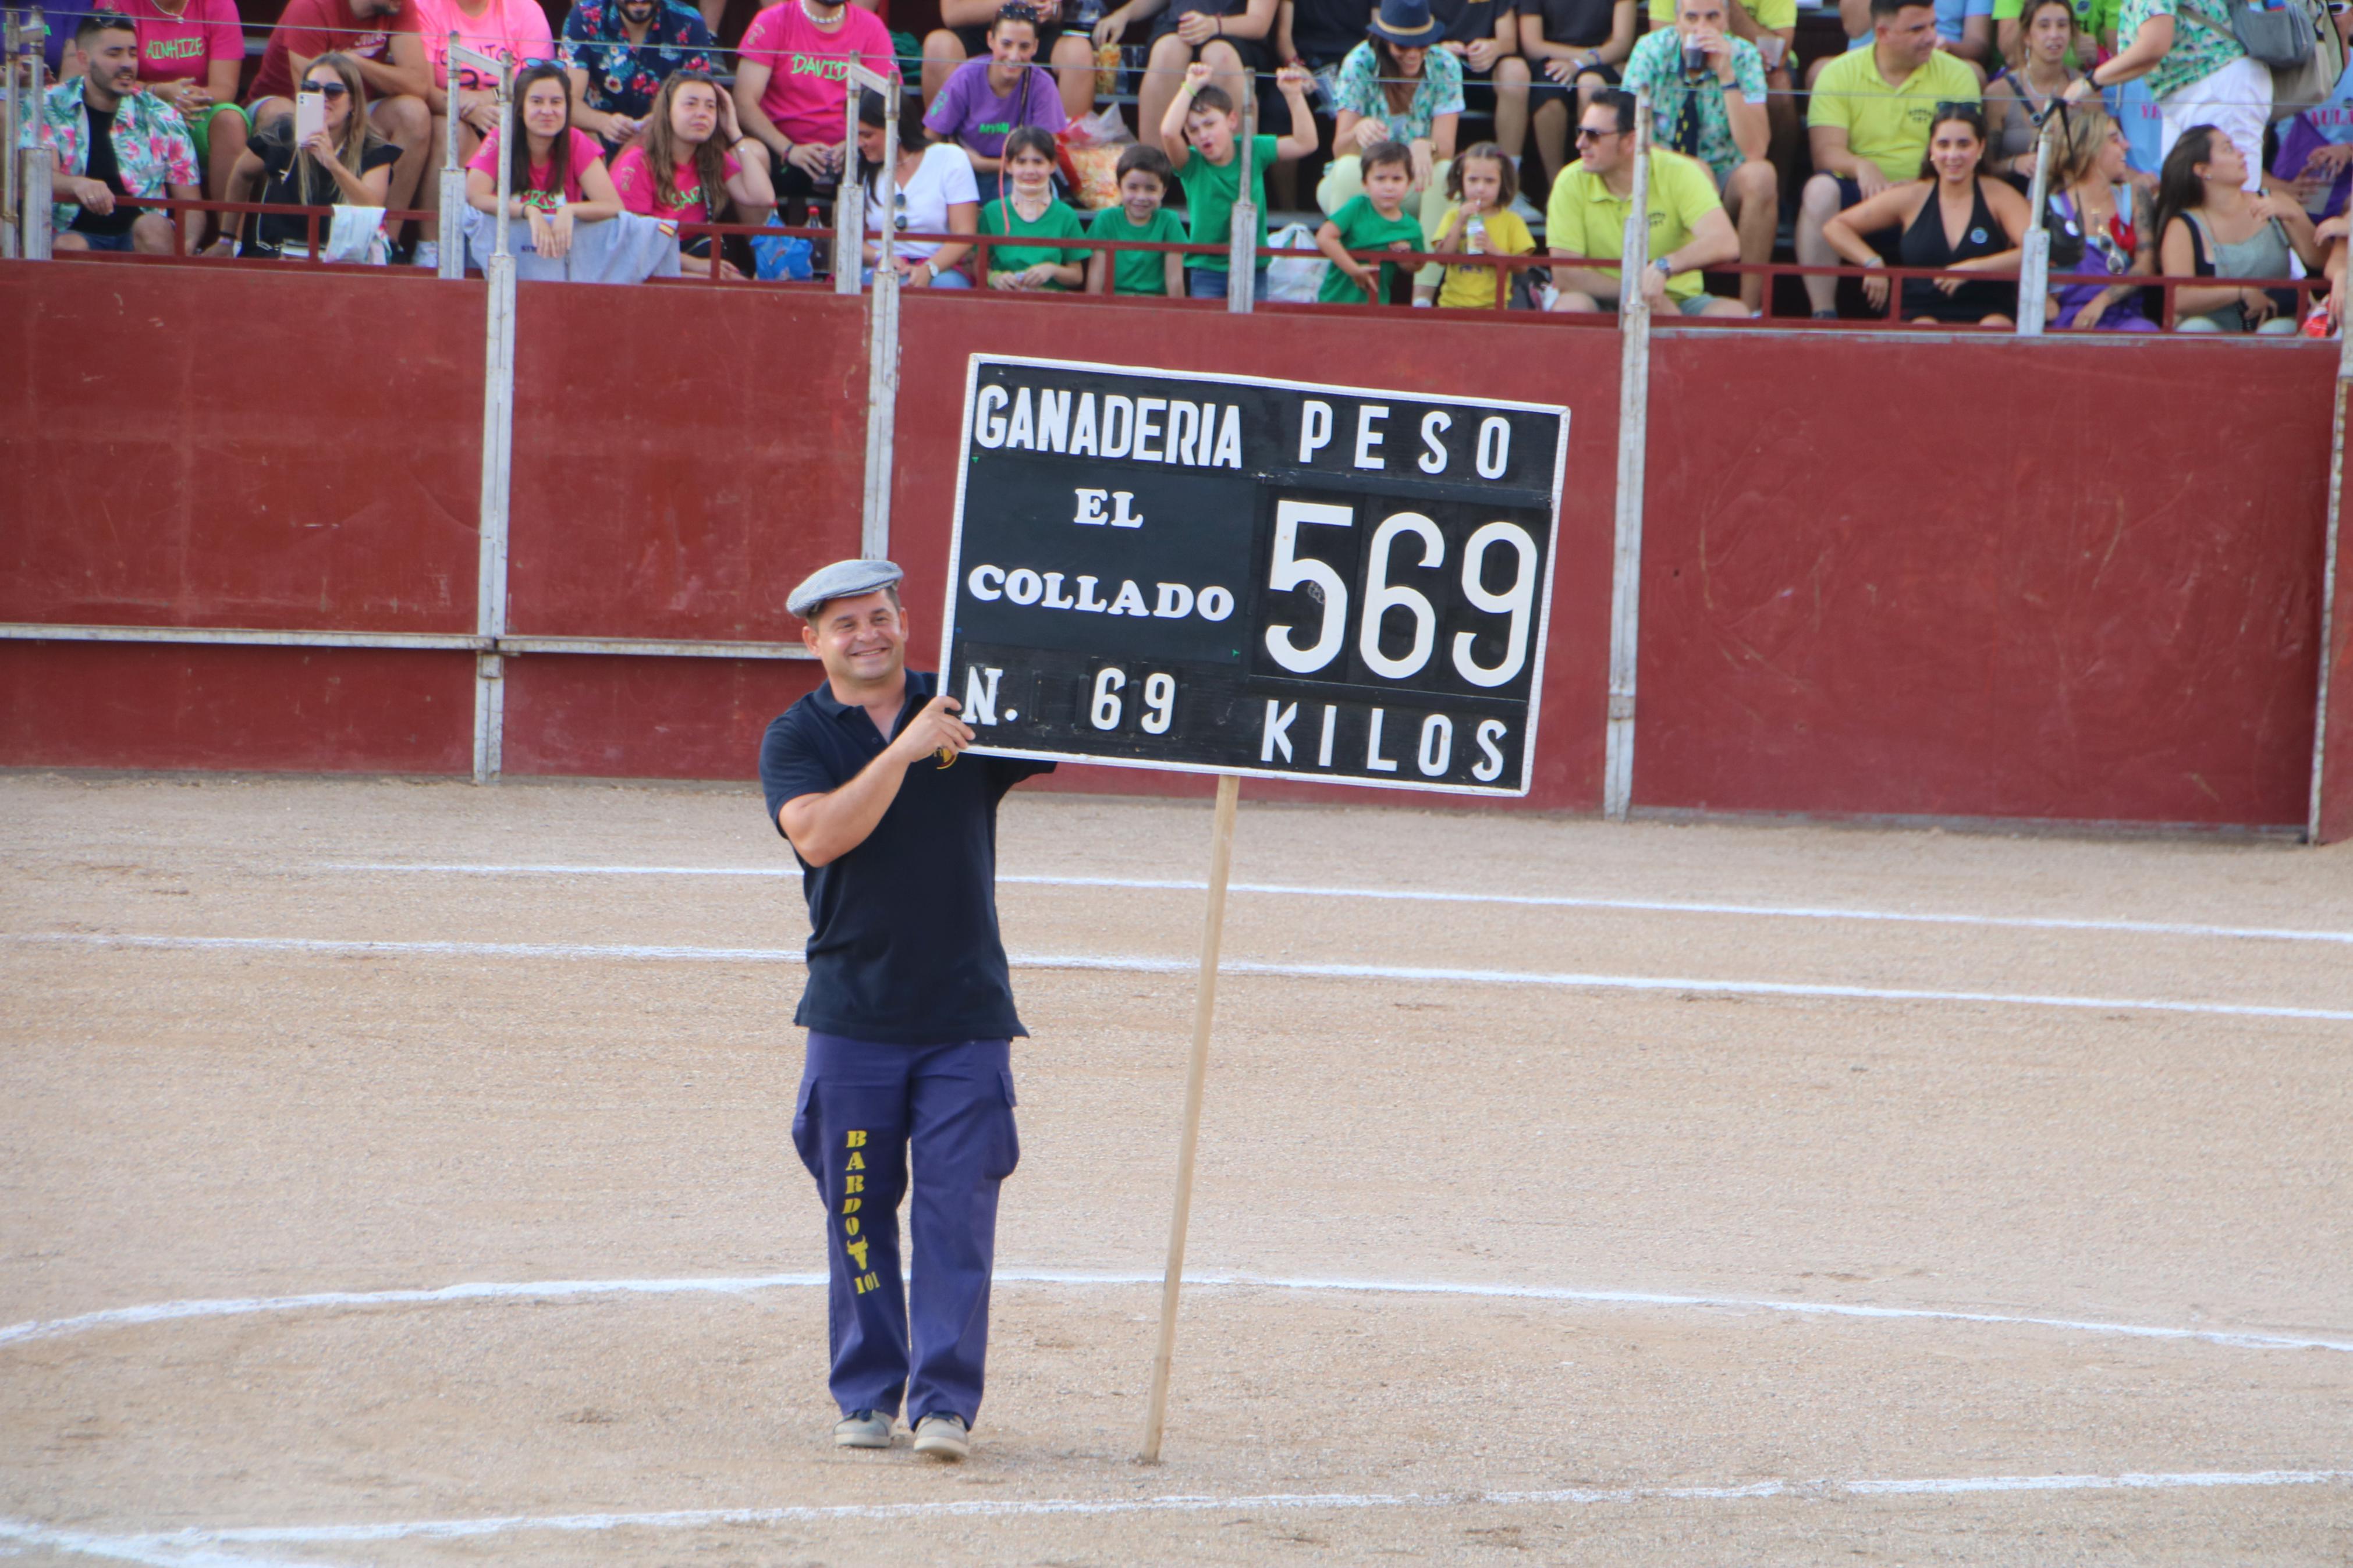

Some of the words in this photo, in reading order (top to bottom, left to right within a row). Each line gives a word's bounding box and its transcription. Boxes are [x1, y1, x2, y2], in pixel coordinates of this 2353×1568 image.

[145, 37, 205, 59] AINHIZE
[792, 54, 848, 81] DAVID
[974, 385, 1242, 469] GANADERIA
[1298, 400, 1511, 479] PESO
[1073, 488, 1144, 528] EL
[968, 564, 1235, 621] COLLADO
[1265, 500, 1538, 688] 569
[961, 666, 1017, 726] N.
[1090, 667, 1176, 735] 69
[1260, 699, 1507, 782] KILOS
[842, 1130, 867, 1236] BARDO
[854, 1271, 881, 1295] 101
